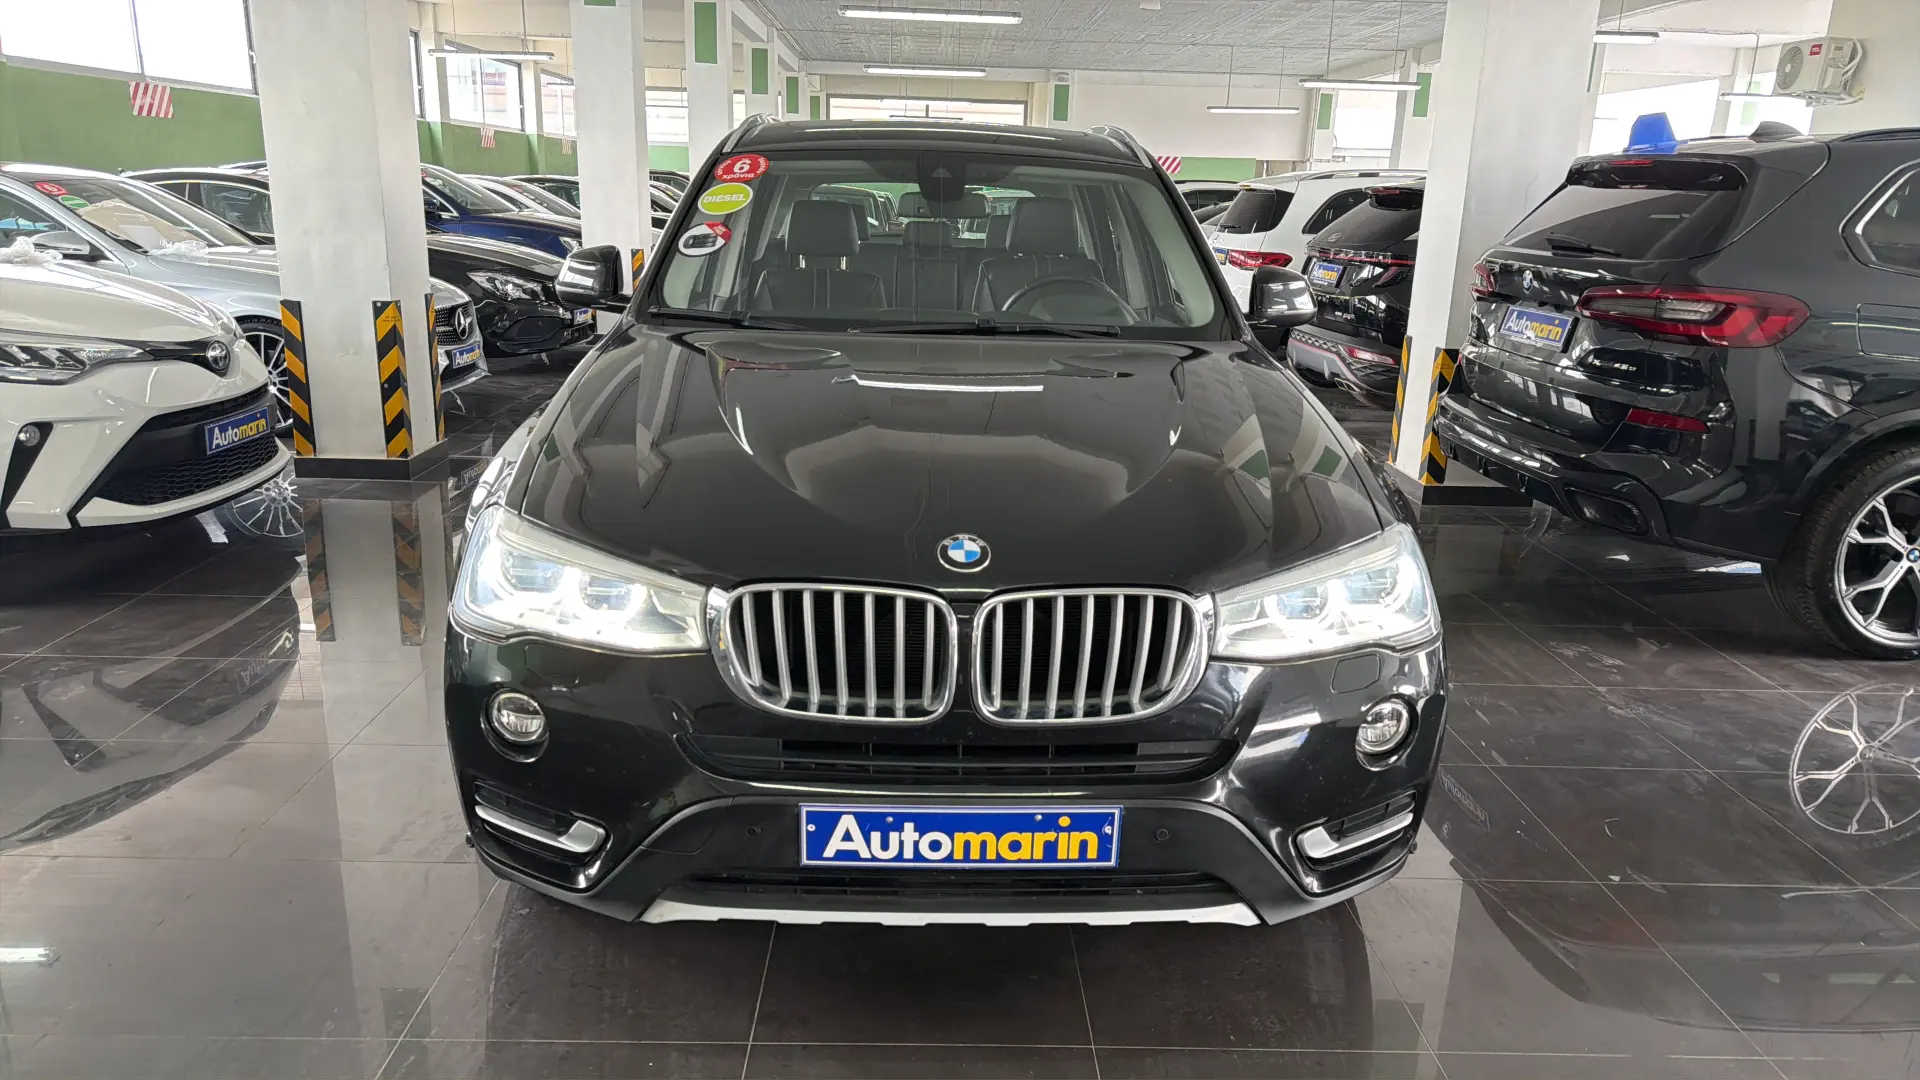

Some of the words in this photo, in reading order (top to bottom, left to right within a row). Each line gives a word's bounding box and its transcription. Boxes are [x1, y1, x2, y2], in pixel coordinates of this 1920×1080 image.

[733, 160, 752, 173] 6
[703, 193, 747, 203] DIESEL
[1505, 311, 1563, 341] Automarin
[211, 412, 267, 449] Automarin
[822, 813, 1099, 861] Automarin
